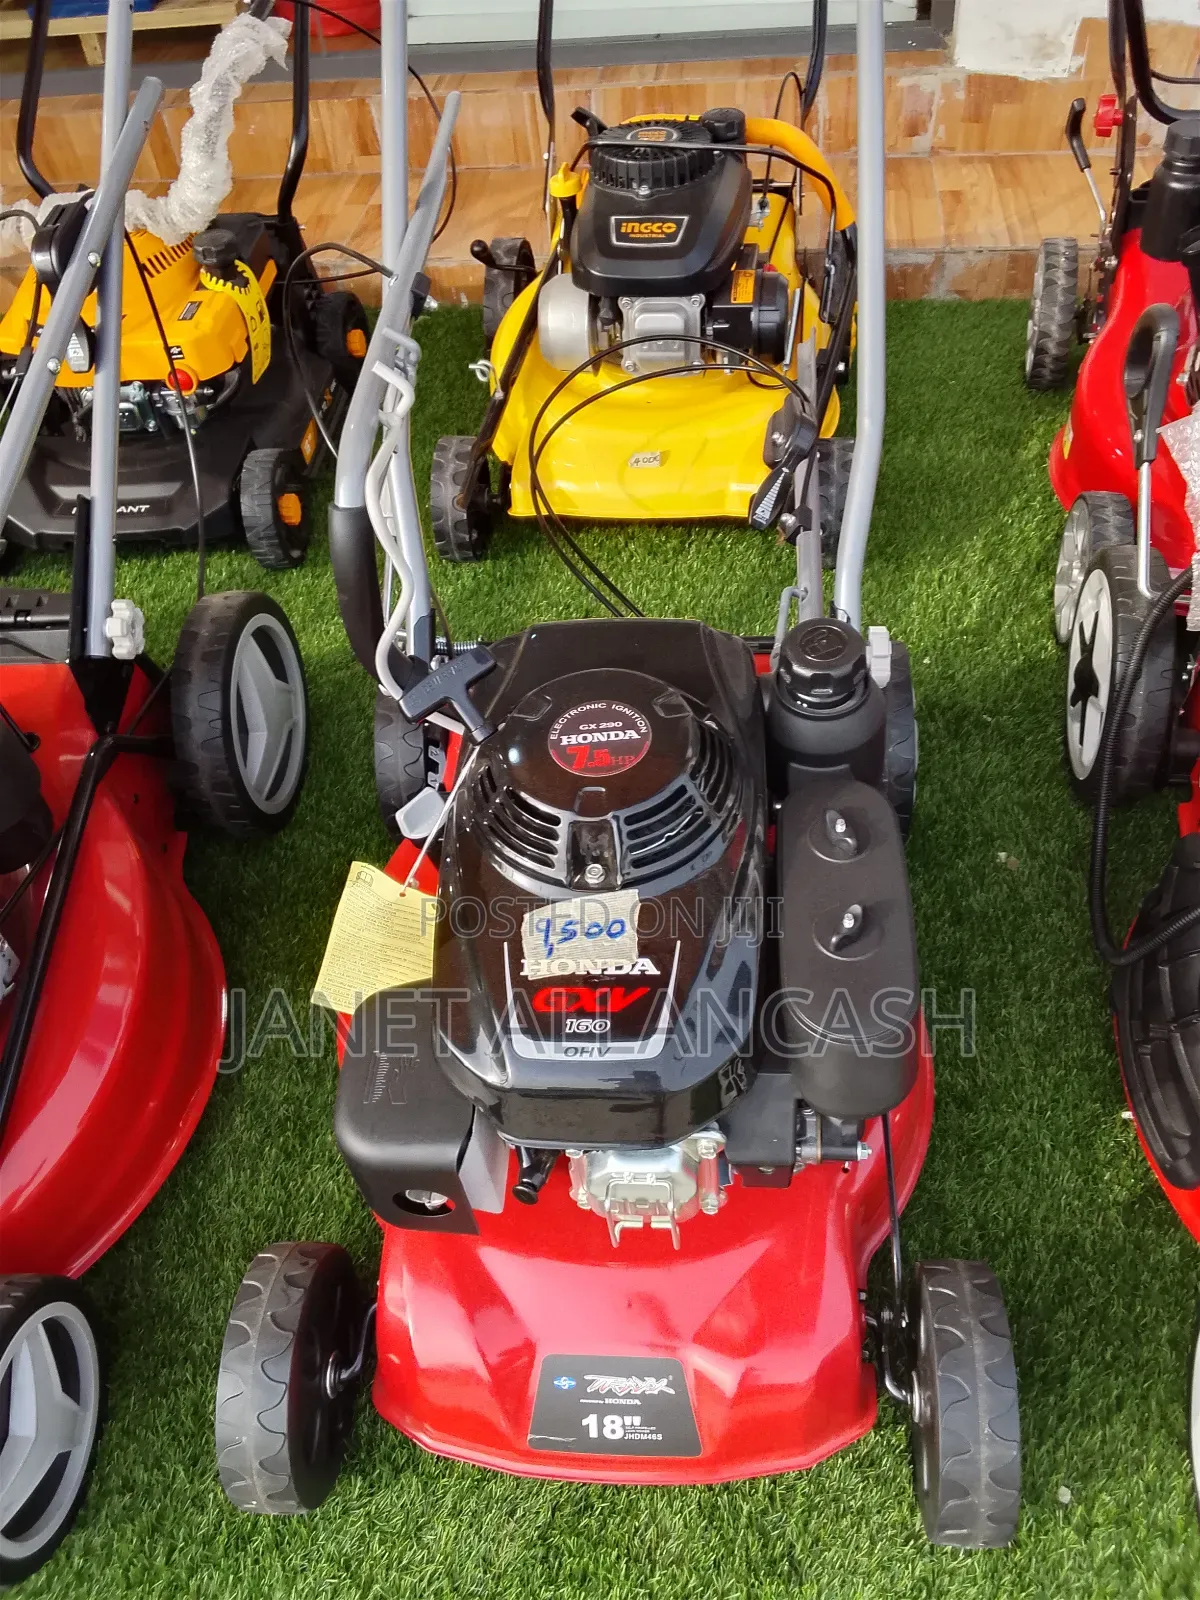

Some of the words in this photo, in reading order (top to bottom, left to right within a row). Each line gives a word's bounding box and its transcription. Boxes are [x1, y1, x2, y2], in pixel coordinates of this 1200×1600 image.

[550, 703, 607, 740] ELECTRONIC
[611, 704, 649, 734] IGNITION
[598, 721, 623, 729] 290
[560, 729, 641, 745] HONDA
[520, 957, 661, 976] HONDA
[532, 986, 651, 1013] GXV
[565, 1018, 611, 1033] 160
[563, 1046, 612, 1058] OHV
[605, 1398, 642, 1406] HONDA
[624, 1433, 663, 1441] JHDM46S
